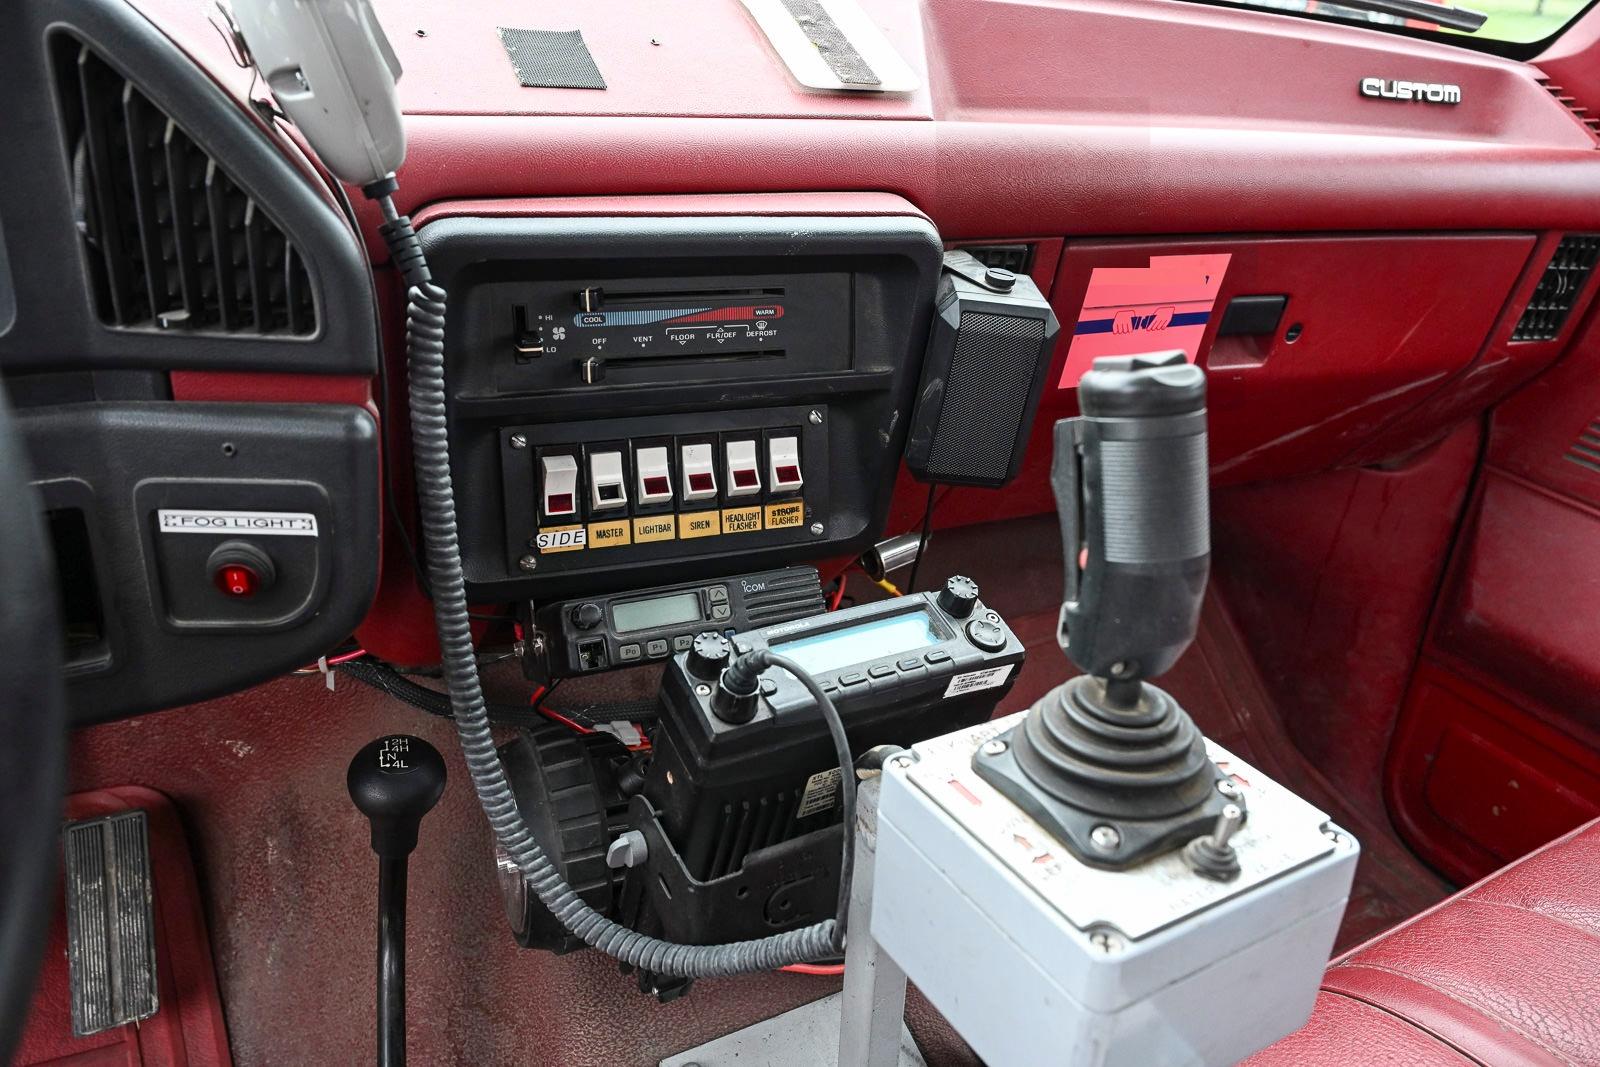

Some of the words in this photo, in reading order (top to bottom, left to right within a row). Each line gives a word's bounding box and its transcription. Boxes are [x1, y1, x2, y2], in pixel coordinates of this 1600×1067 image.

[1361, 77, 1462, 104] CUSTOM
[755, 307, 775, 316] WARM
[583, 315, 603, 324] COOL
[670, 333, 695, 342] FLOOR
[706, 330, 737, 340] FLR/DEF
[746, 328, 778, 338] DEFROST
[592, 336, 607, 345] OFF
[633, 334, 653, 343] VENT
[546, 346, 557, 354] LO
[181, 516, 228, 528] FOG
[234, 517, 297, 529] LIGHT
[725, 511, 760, 524] HEADLIGHT
[771, 515, 800, 526] FLASHER
[638, 522, 672, 536] LIGHTBAR
[690, 519, 711, 531] SIREN
[728, 520, 758, 532] FLASHER
[595, 527, 624, 539] MASTER
[537, 529, 586, 549] SIDE
[766, 621, 811, 636] MOTOROLA
[391, 738, 409, 746] 2H
[391, 745, 409, 753] 4H
[386, 753, 398, 761] N
[392, 760, 409, 769] 4L
